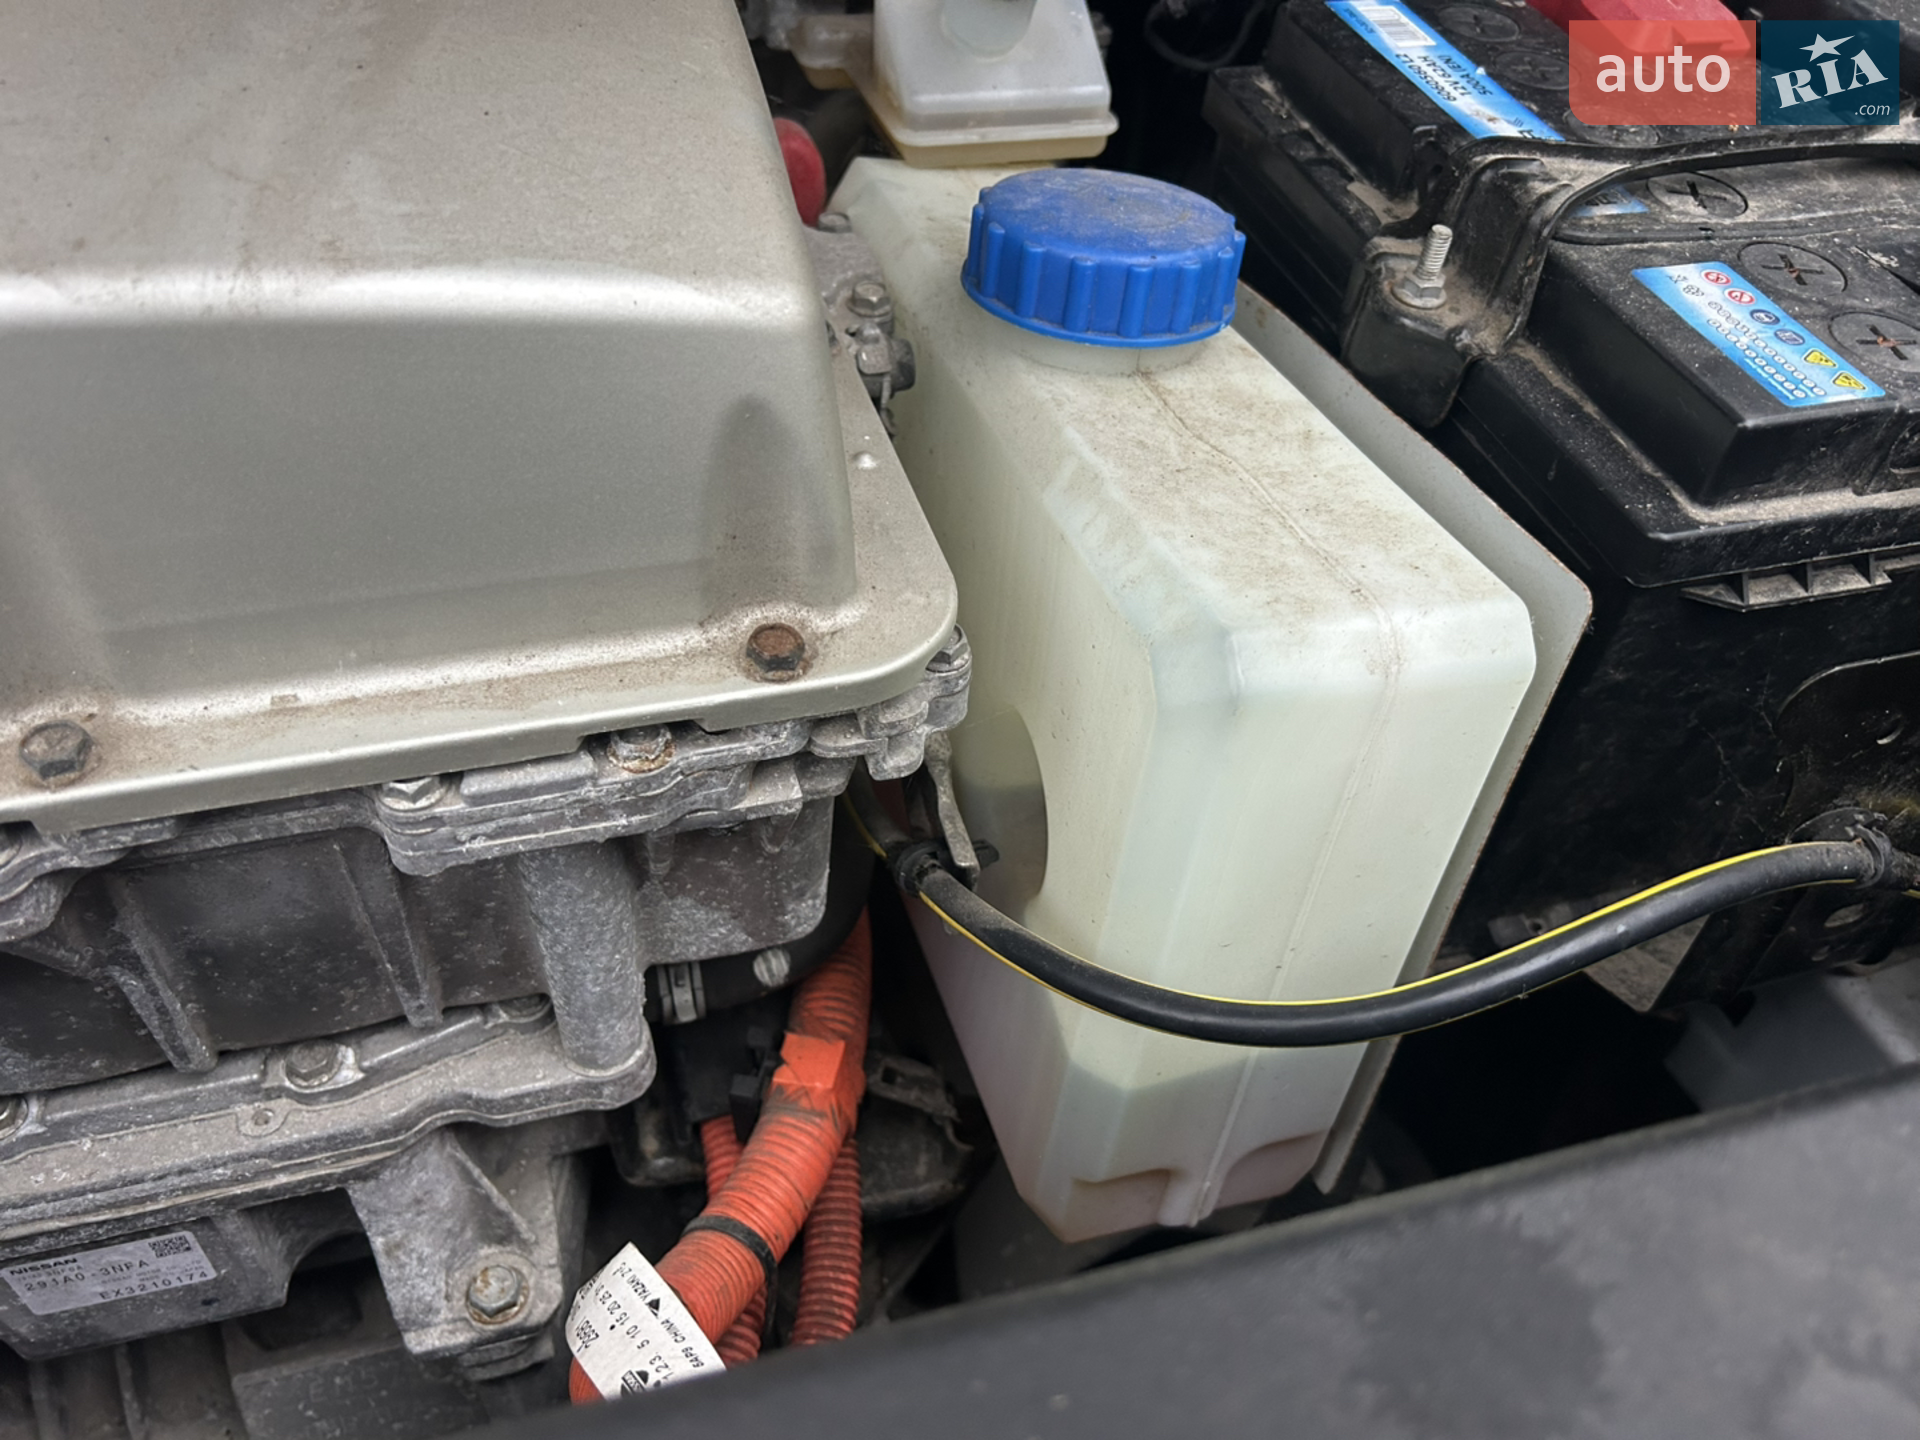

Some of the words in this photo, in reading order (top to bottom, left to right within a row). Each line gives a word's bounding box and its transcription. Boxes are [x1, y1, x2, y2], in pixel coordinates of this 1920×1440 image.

[1418, 55, 1452, 79] 62AH
[1444, 79, 1472, 97] 12V
[9, 1257, 78, 1276] NISSAN
[626, 1274, 652, 1302] YAZAKI
[607, 1300, 622, 1315] 20
[615, 1311, 630, 1327] 15
[625, 1324, 642, 1339] 10
[660, 1318, 686, 1344] CHINA
[636, 1339, 650, 1350] 5
